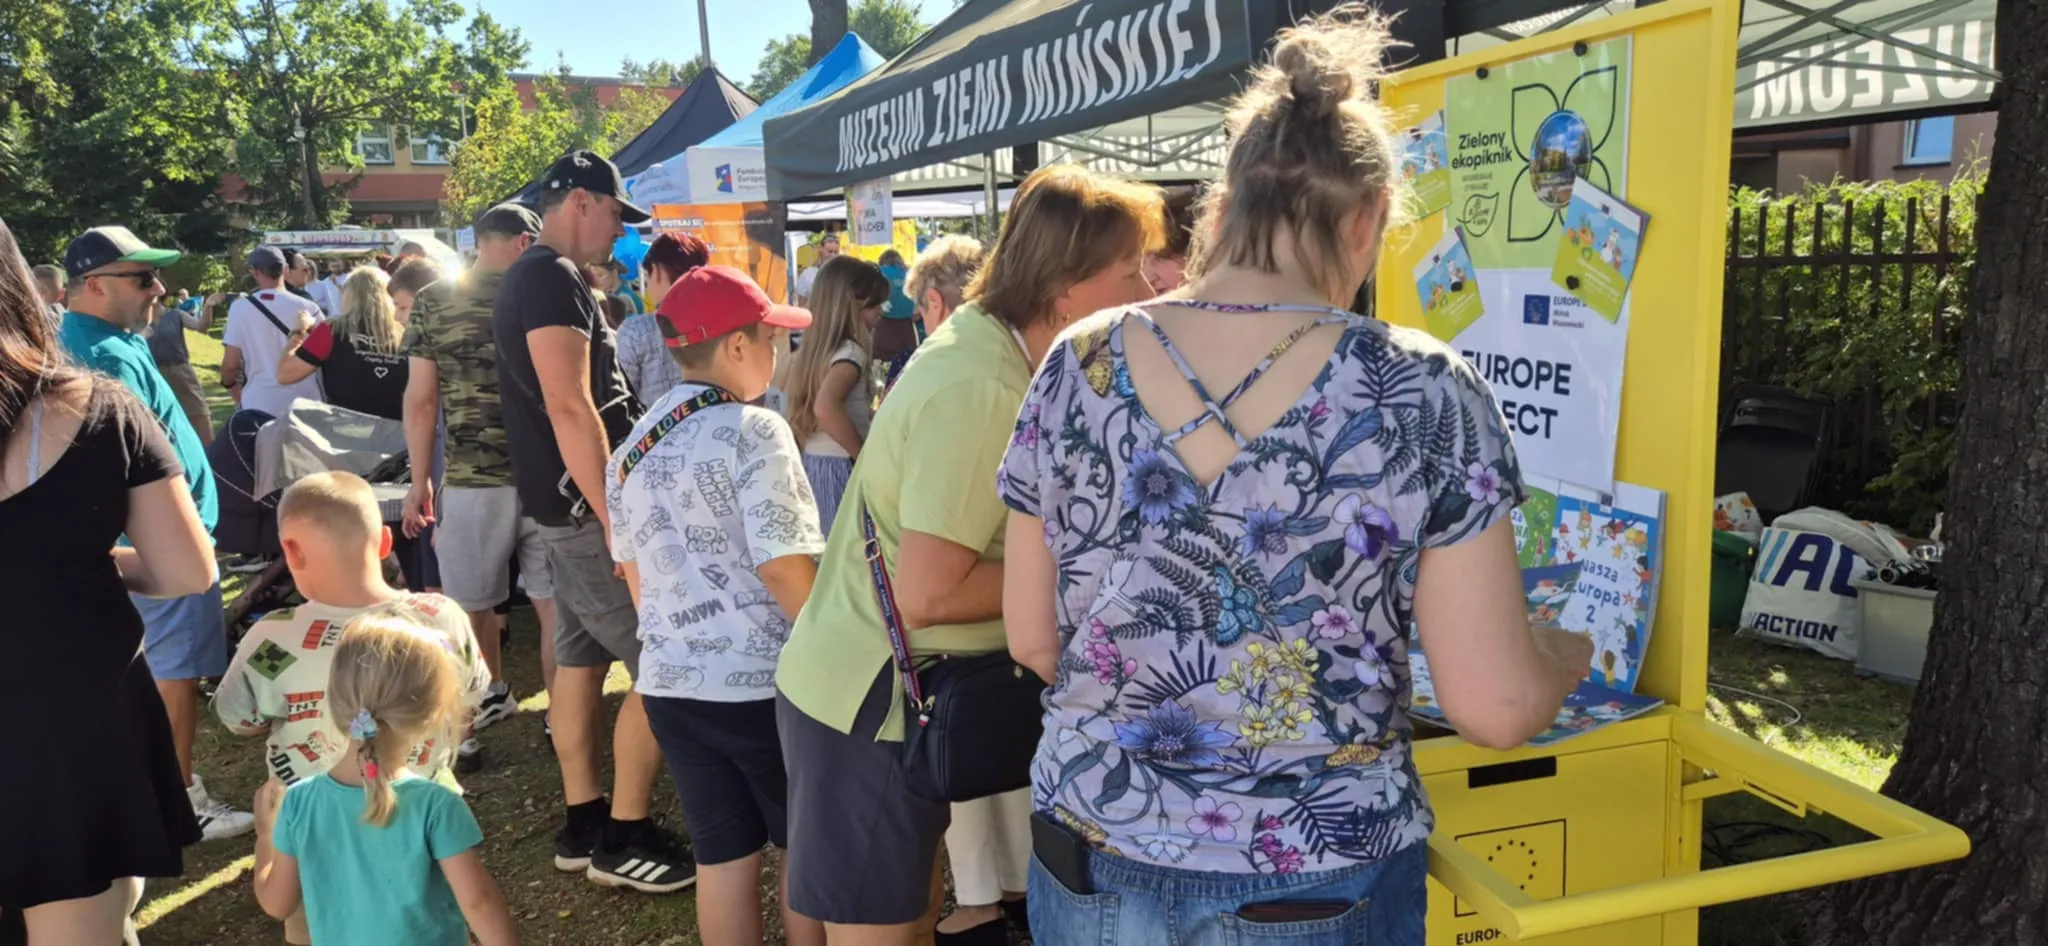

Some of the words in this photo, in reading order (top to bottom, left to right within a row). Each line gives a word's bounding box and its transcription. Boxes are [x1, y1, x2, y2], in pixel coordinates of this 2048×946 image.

[836, 88, 925, 173] MUZEUM
[927, 54, 1011, 148] ZIEMI
[1017, 0, 1222, 126] MIŃSKIEJ
[1458, 131, 1506, 150] Zielony
[1452, 148, 1512, 170] ekopiknik
[656, 403, 691, 437] LOVE
[625, 432, 655, 470] LOVE
[1586, 604, 1596, 624] 2
[321, 623, 342, 648] TNT
[1753, 612, 1839, 643] ACTION
[287, 700, 318, 713] TNT
